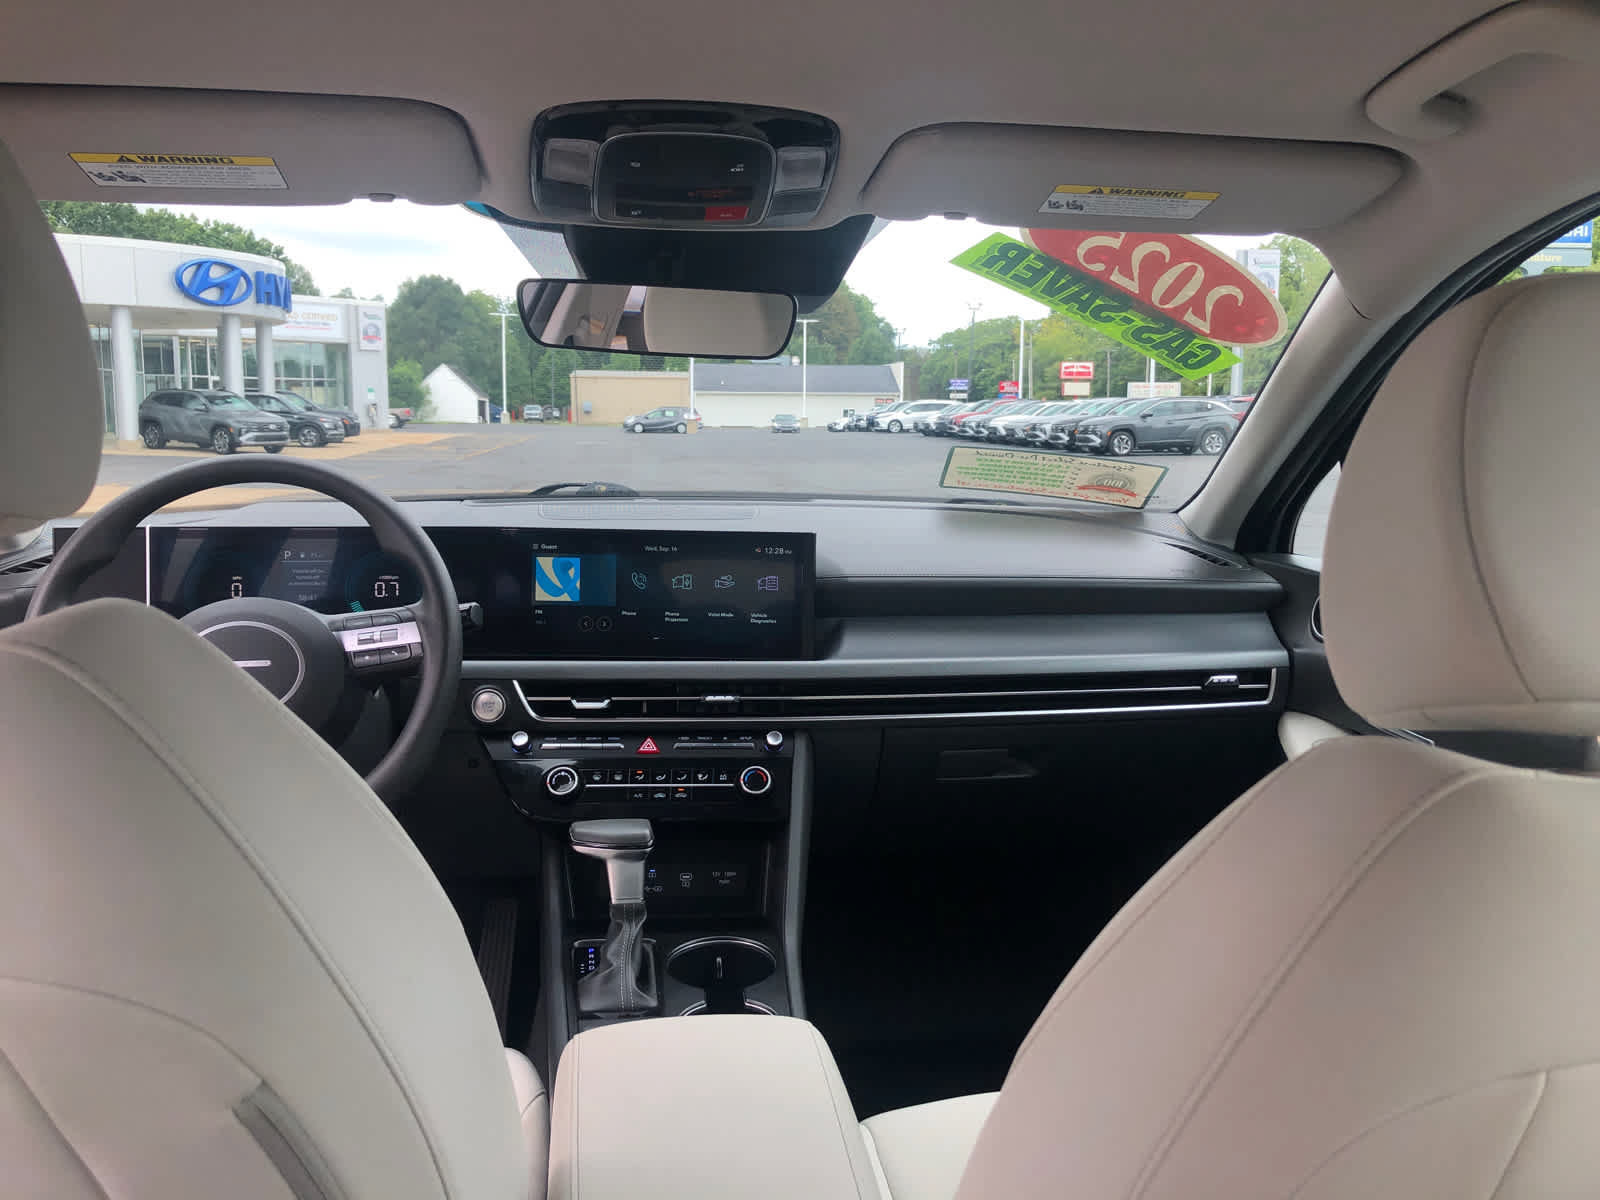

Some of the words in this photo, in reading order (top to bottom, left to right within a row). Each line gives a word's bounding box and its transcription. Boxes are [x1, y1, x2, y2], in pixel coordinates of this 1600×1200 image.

[137, 154, 234, 164] WARNING
[1109, 187, 1186, 199] WARNING
[540, 543, 558, 551] Guest
[764, 546, 784, 555] 12:28
[284, 550, 292, 560] P
[231, 582, 242, 599] 0
[374, 581, 399, 598] 0.7
